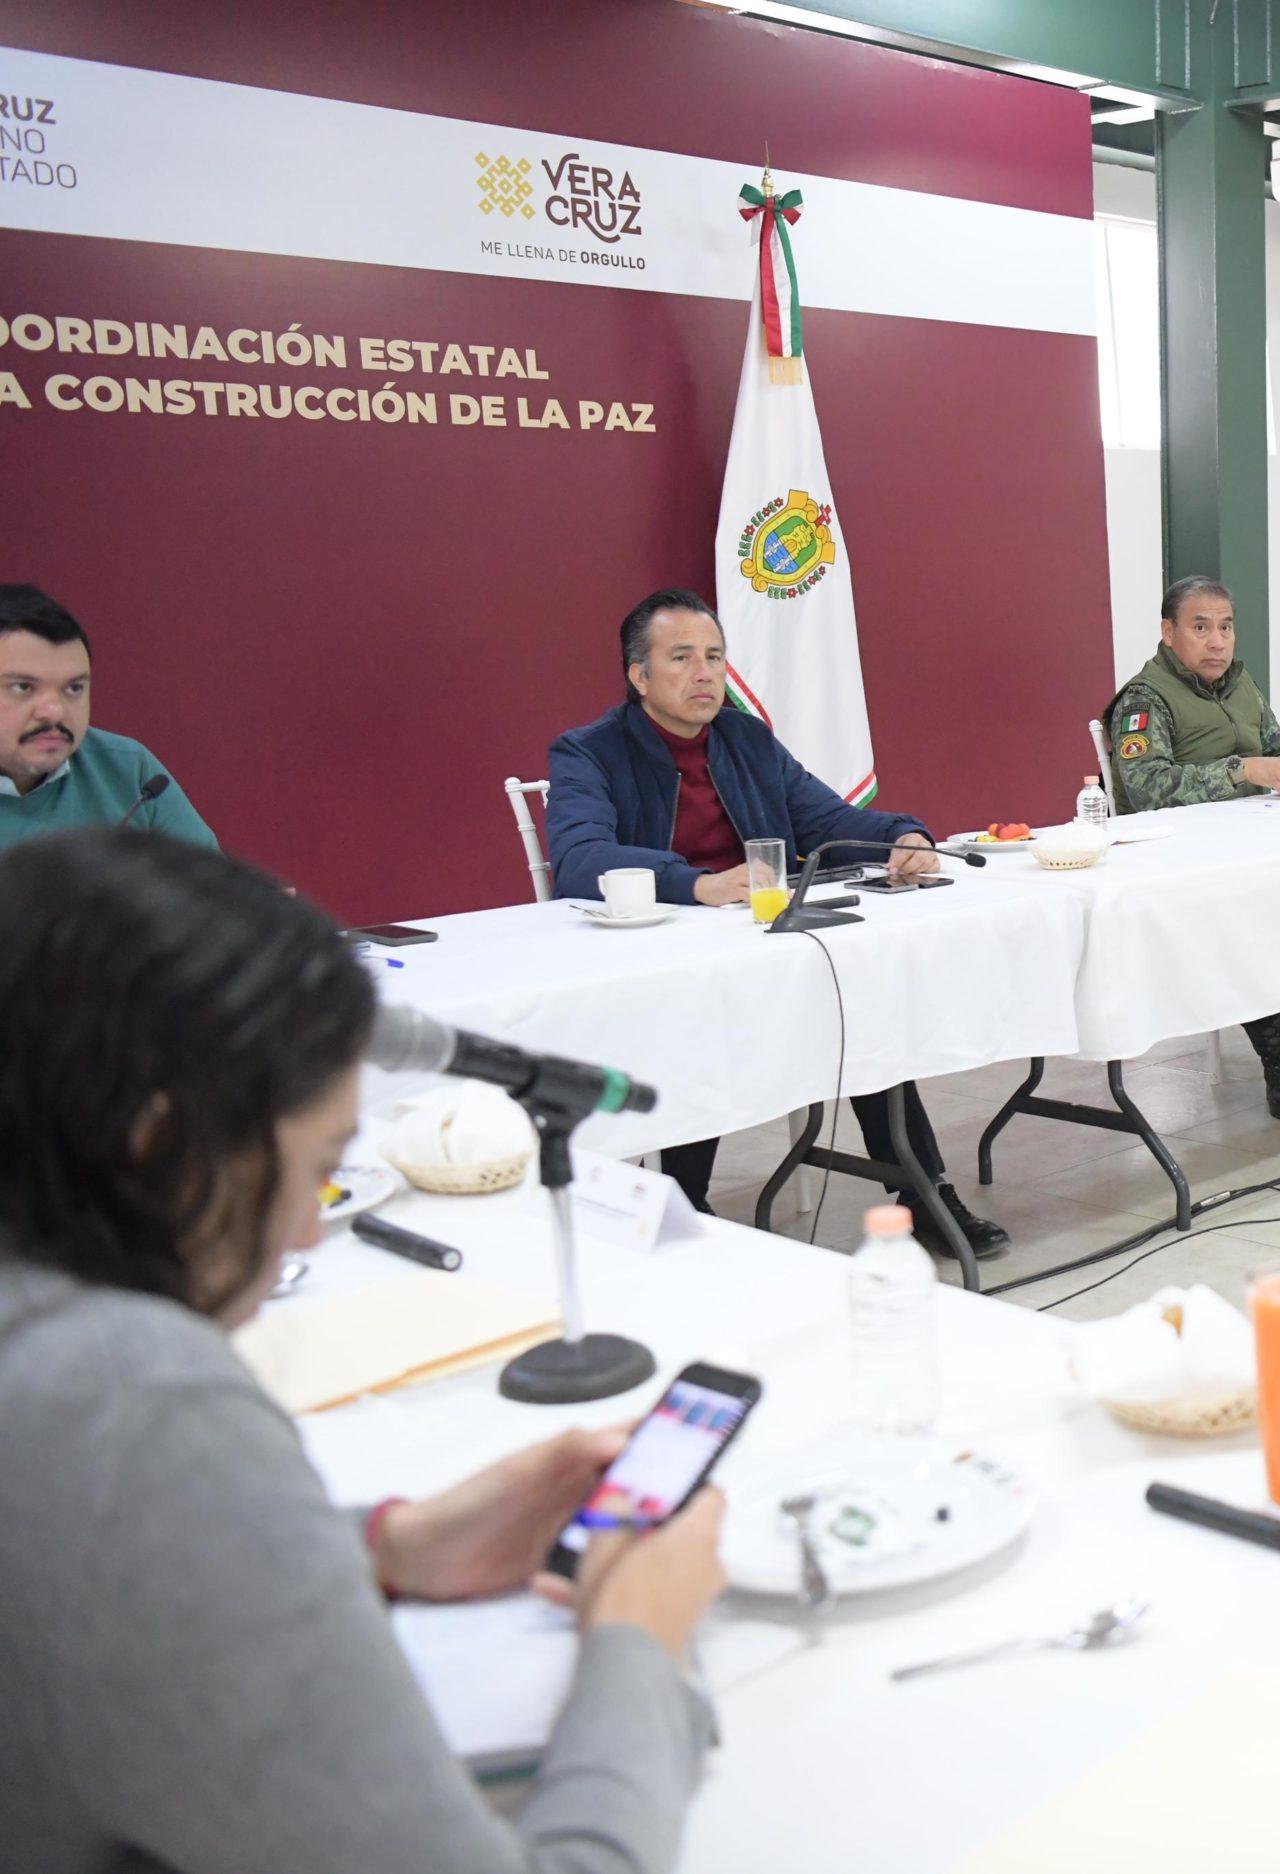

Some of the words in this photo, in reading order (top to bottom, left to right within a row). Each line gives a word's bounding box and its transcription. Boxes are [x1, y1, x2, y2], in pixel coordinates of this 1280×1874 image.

[0, 124, 46, 154] NO
[541, 153, 641, 203] VERA
[545, 195, 642, 244] CRUZ
[480, 240, 503, 256] ME
[507, 243, 555, 261] LLENA
[559, 249, 577, 264] DE
[580, 251, 646, 270] ORGULLO
[0, 313, 347, 369] ORDINACIÓN
[359, 337, 549, 381] ESTATAL
[0, 371, 32, 409] A
[44, 373, 438, 424] CONSTRUCCIÓN
[449, 394, 507, 428] DE
[517, 397, 571, 430] LA
[578, 400, 656, 433] PAZ
